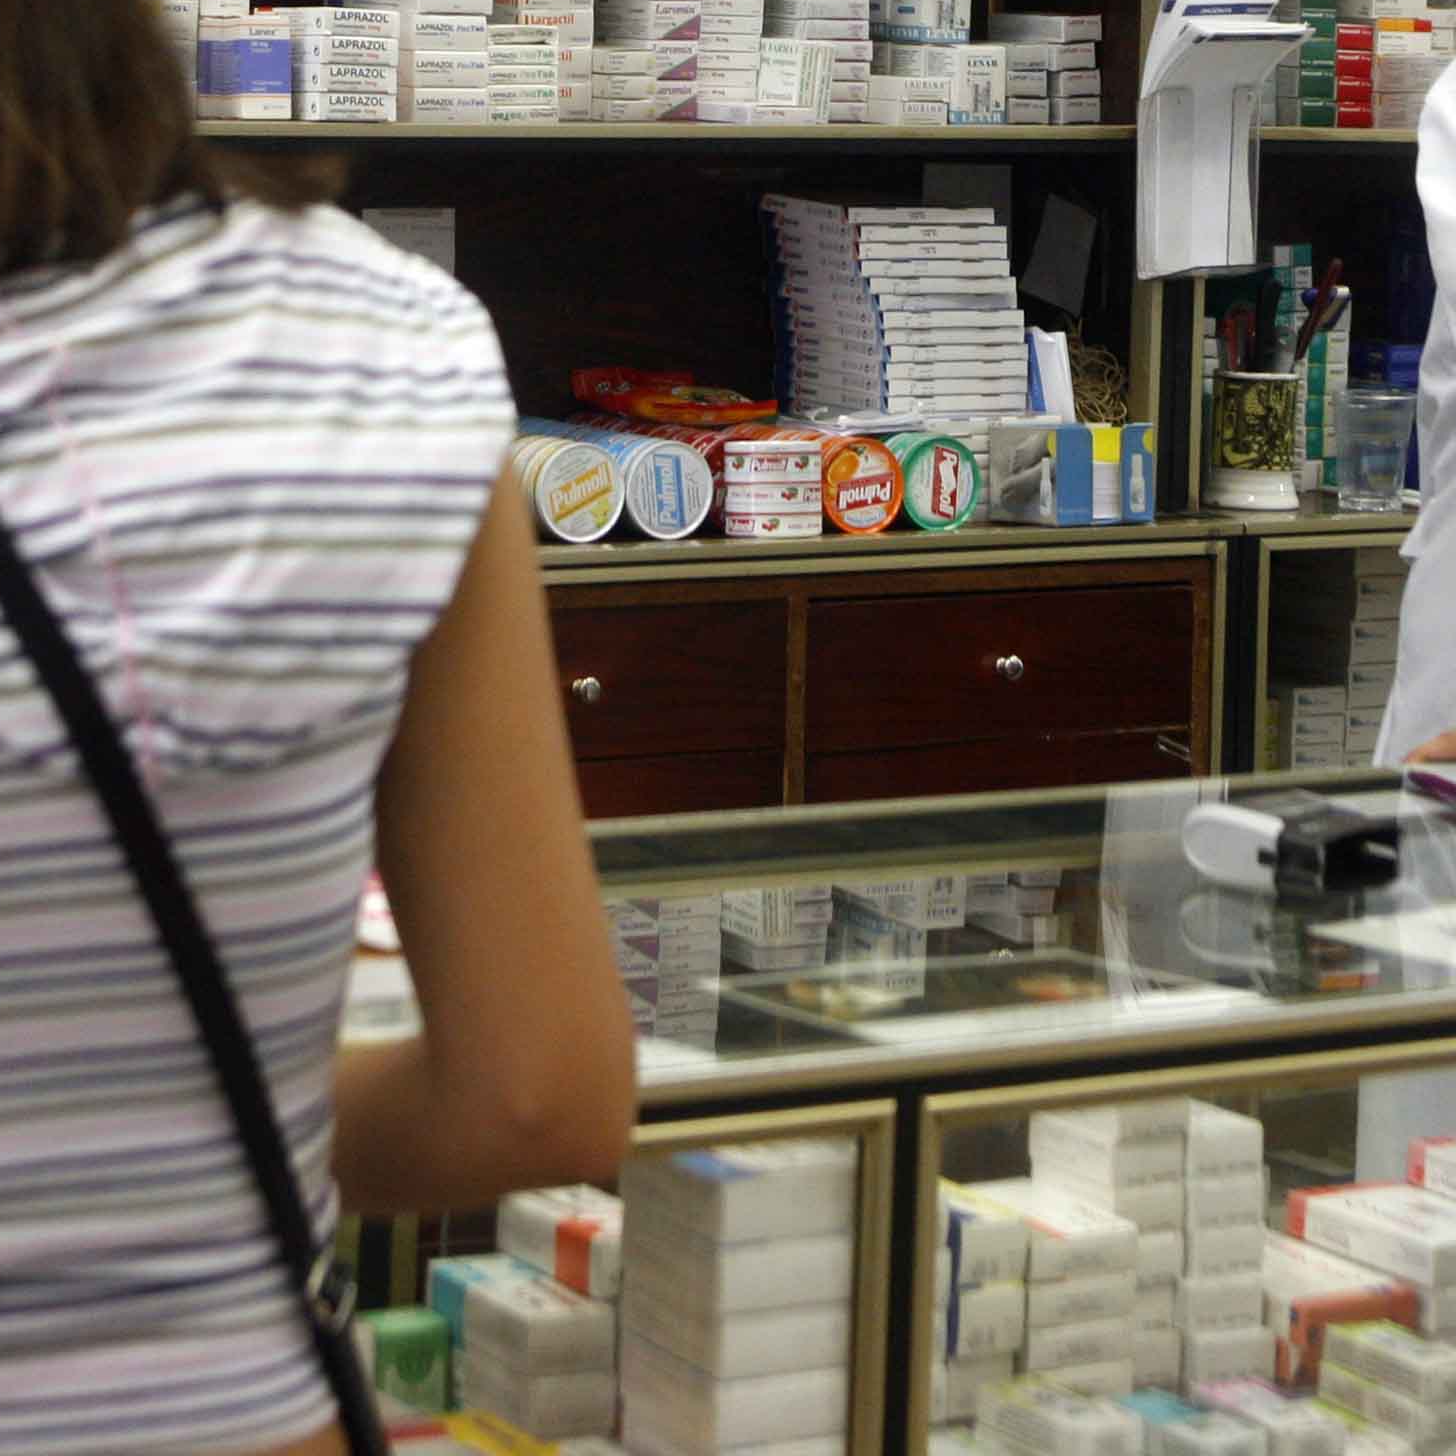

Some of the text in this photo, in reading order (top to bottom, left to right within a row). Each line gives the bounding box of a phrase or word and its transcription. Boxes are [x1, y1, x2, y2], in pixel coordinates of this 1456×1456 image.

[334, 10, 390, 24] LAPRAZOL
[416, 23, 455, 32] LAPRAZOL
[332, 38, 387, 51] LAPRAZOL
[330, 67, 386, 80] LAPRAZOL
[329, 95, 385, 107] LAPRAZOL
[552, 463, 609, 513] Pulmoll
[657, 455, 678, 527] Pulmoll
[839, 479, 892, 506] Pulmoll
